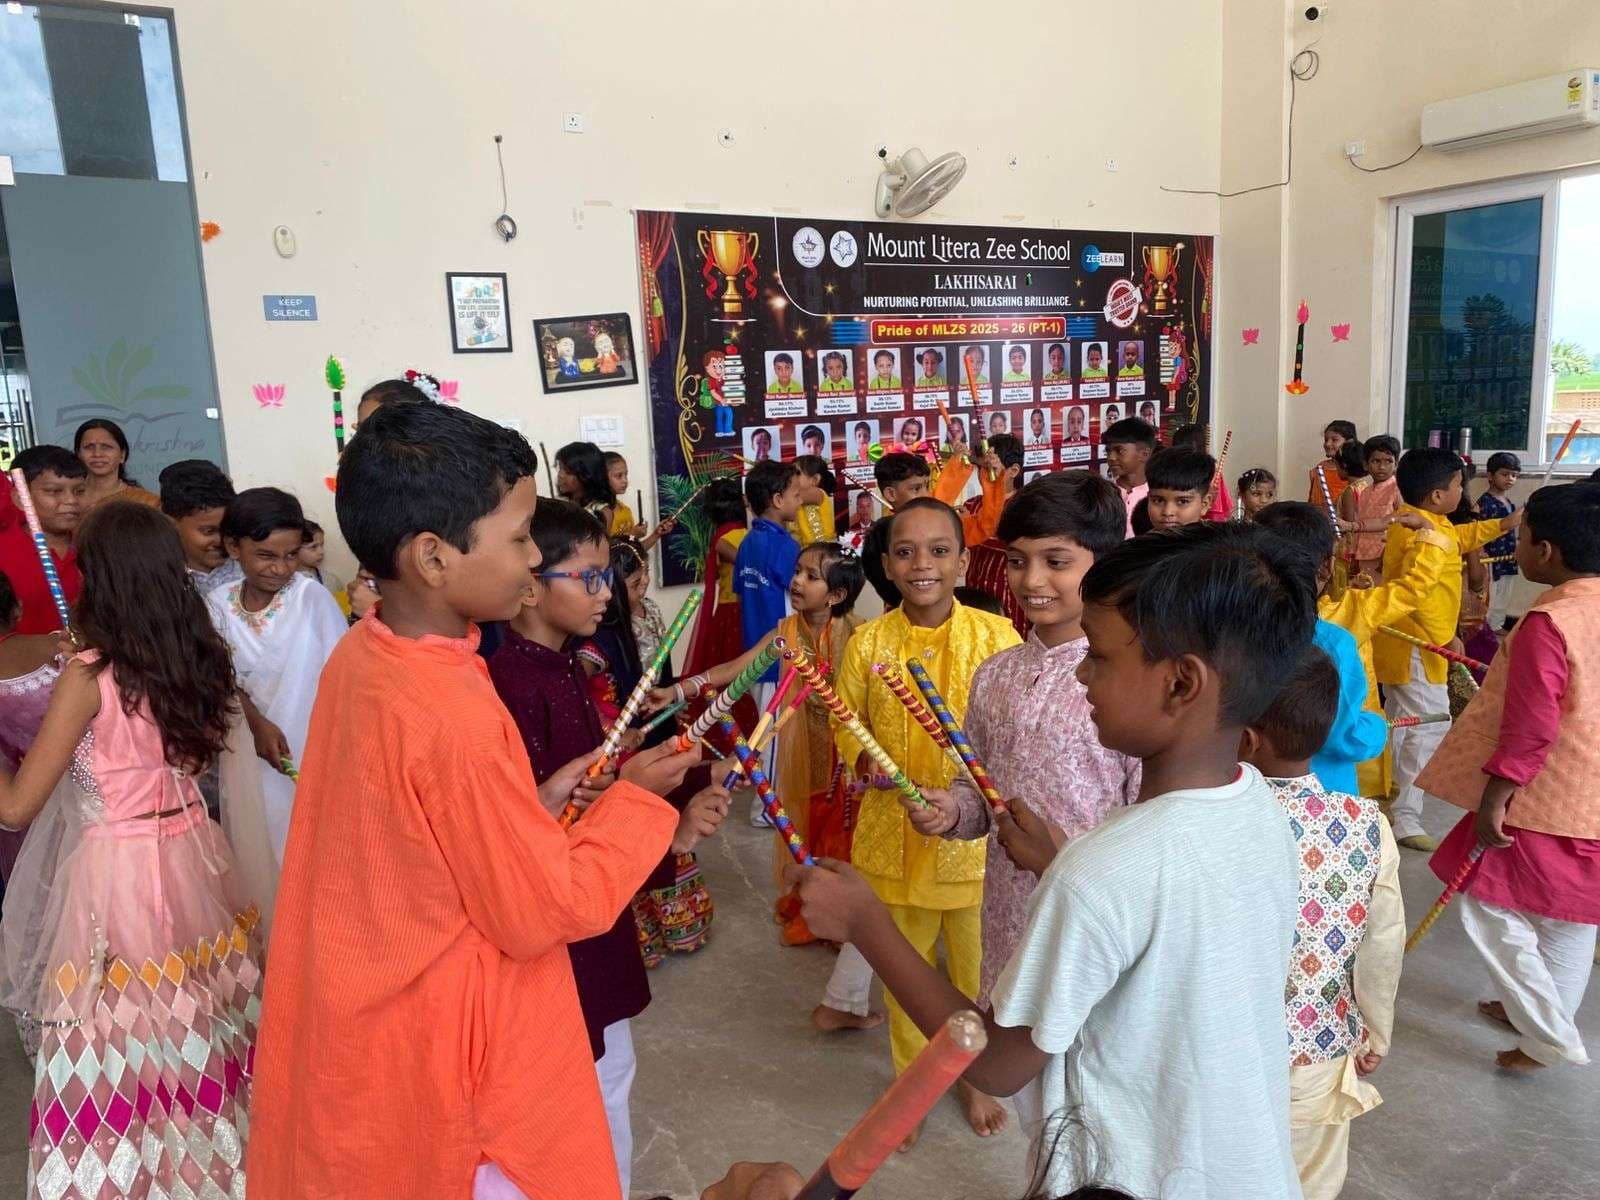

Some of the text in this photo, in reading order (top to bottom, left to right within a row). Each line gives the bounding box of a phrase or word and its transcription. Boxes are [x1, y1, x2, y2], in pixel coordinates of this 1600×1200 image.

[867, 232, 1070, 262] Mount Litera Zee School
[934, 274, 1017, 289] LAKHISARAI
[279, 298, 303, 306] KEEP
[863, 295, 1072, 308] NURTURING POTENTIAL, UNLEASHING BRILLIANCE.
[272, 309, 311, 317] SILENCE
[877, 324, 911, 337] Pride
[915, 324, 928, 336] of
[932, 323, 967, 336] MLZS
[970, 322, 1000, 335] 2025
[1011, 323, 1025, 334] 26
[1028, 322, 1061, 335] (PT-1)
